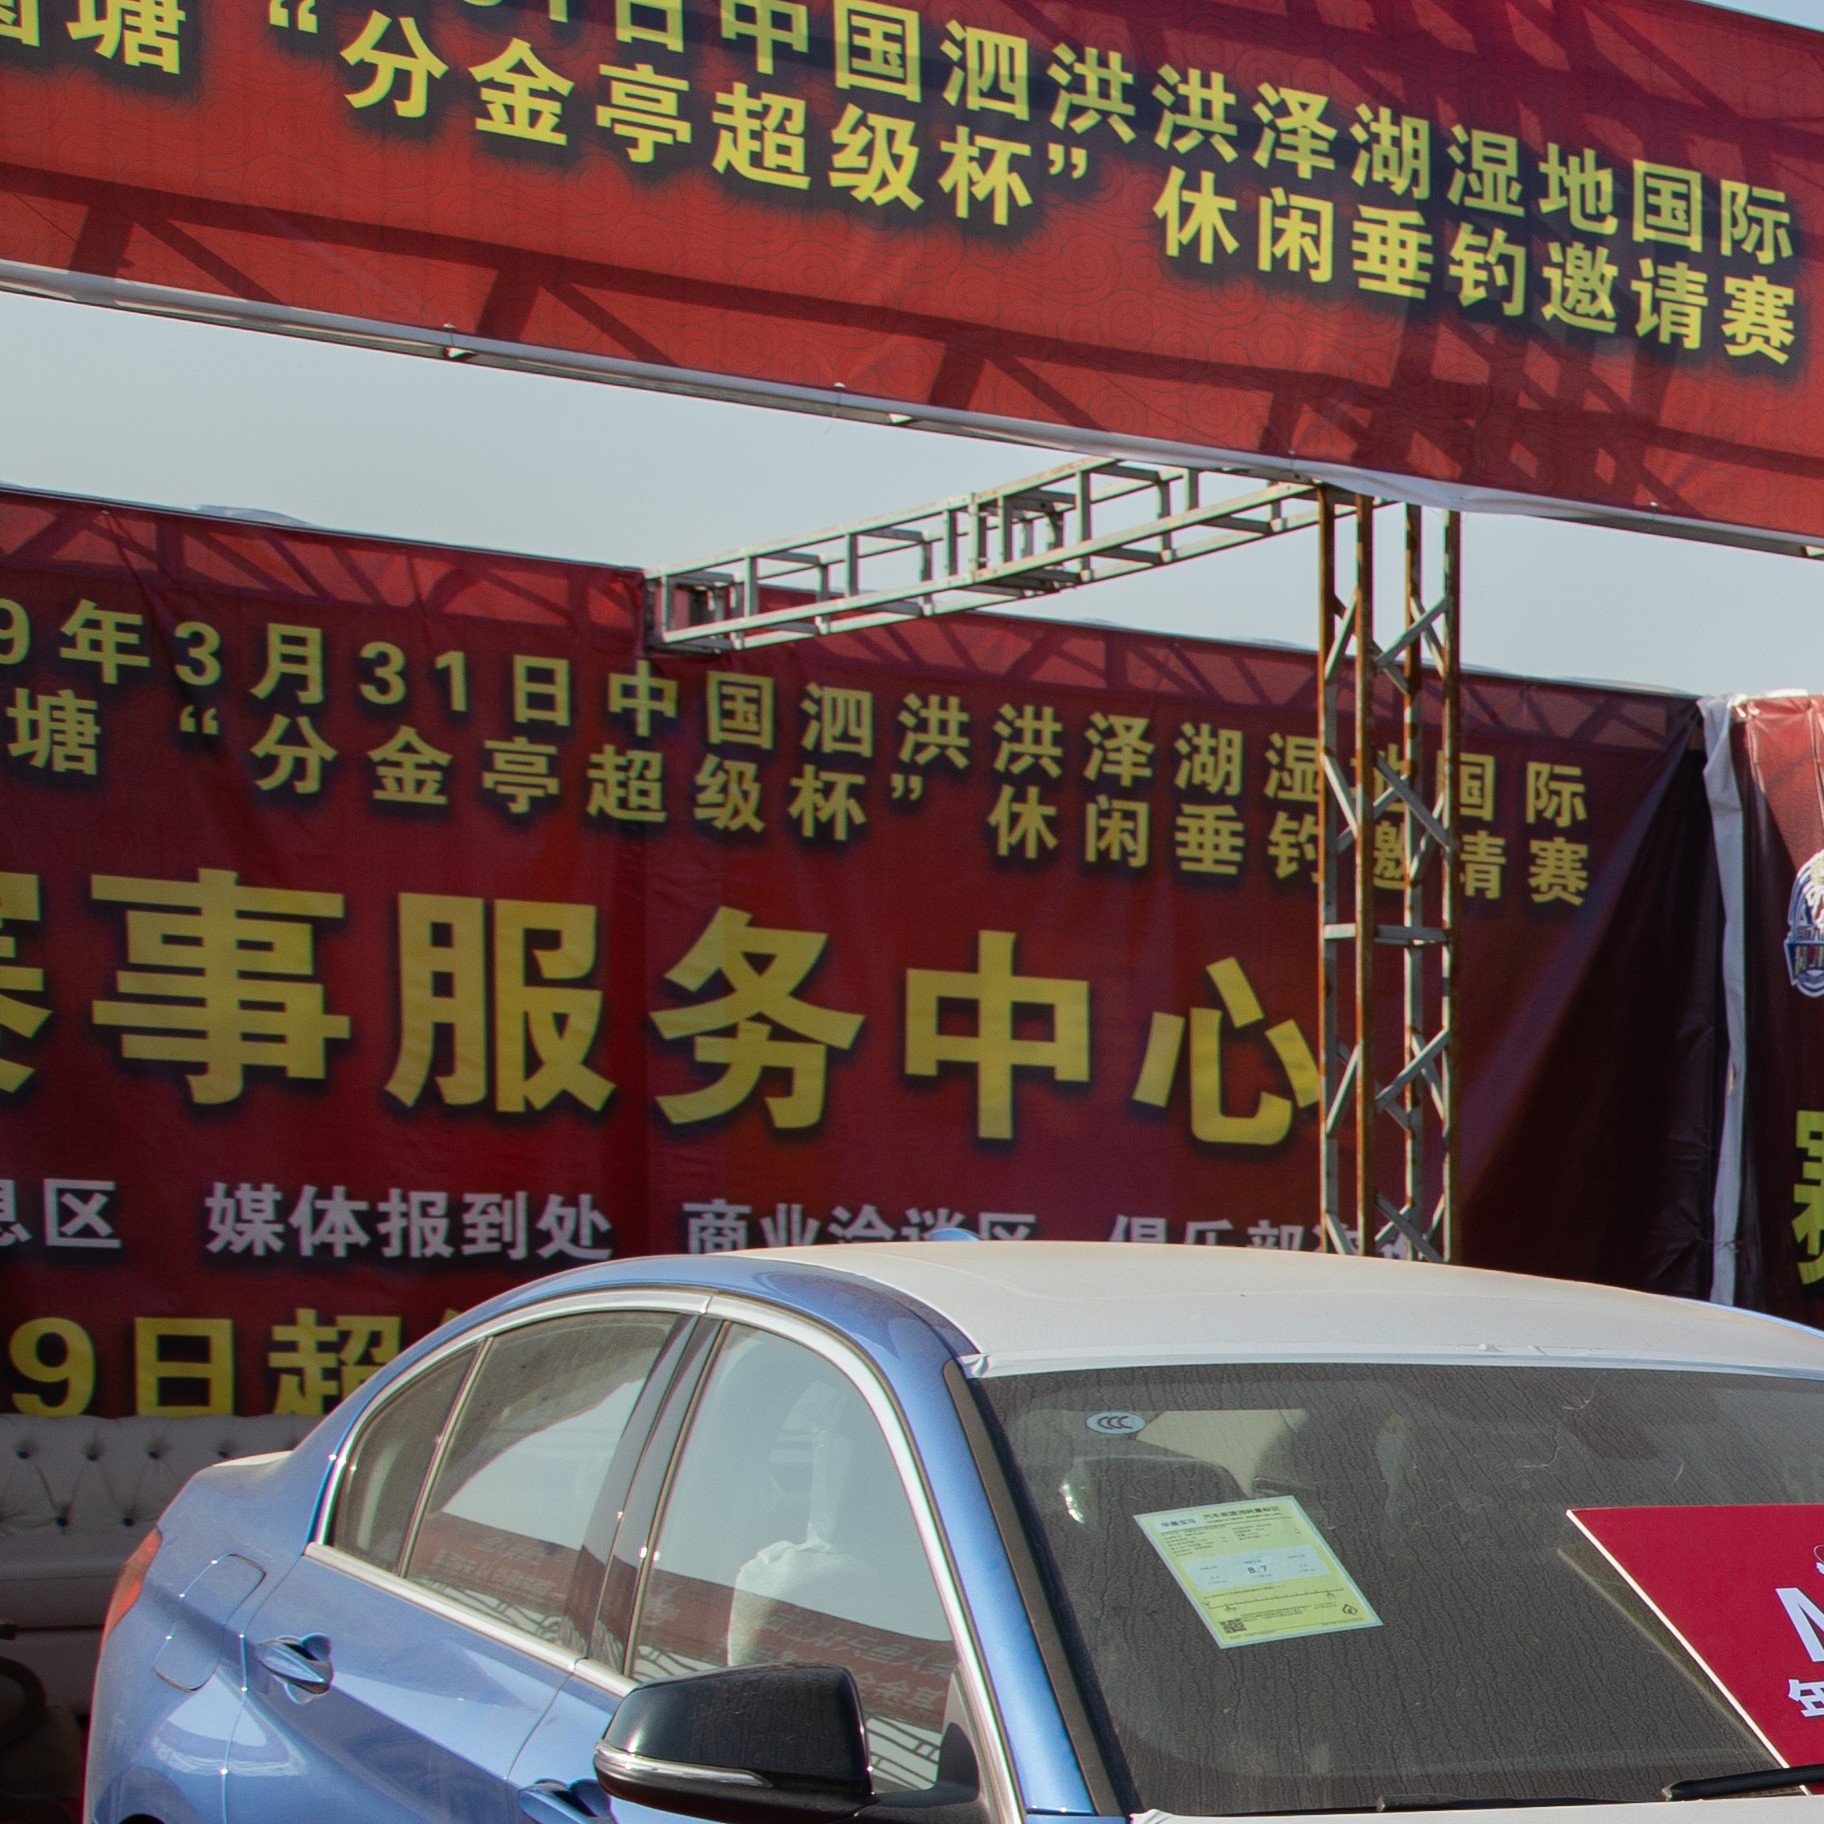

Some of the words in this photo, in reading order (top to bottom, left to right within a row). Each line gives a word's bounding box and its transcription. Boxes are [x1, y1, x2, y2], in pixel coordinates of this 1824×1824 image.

[0, 0, 1796, 365] 塘“分金亭超级杯”休闲垂钓邀请赛
[462, 0, 1794, 265] 日中国泗洪洪泽湖湿地国际
[0, 868, 1321, 1148] 事服务中心
[205, 1181, 613, 1261] 媒体报到处
[8, 1308, 462, 1417] 9日超
